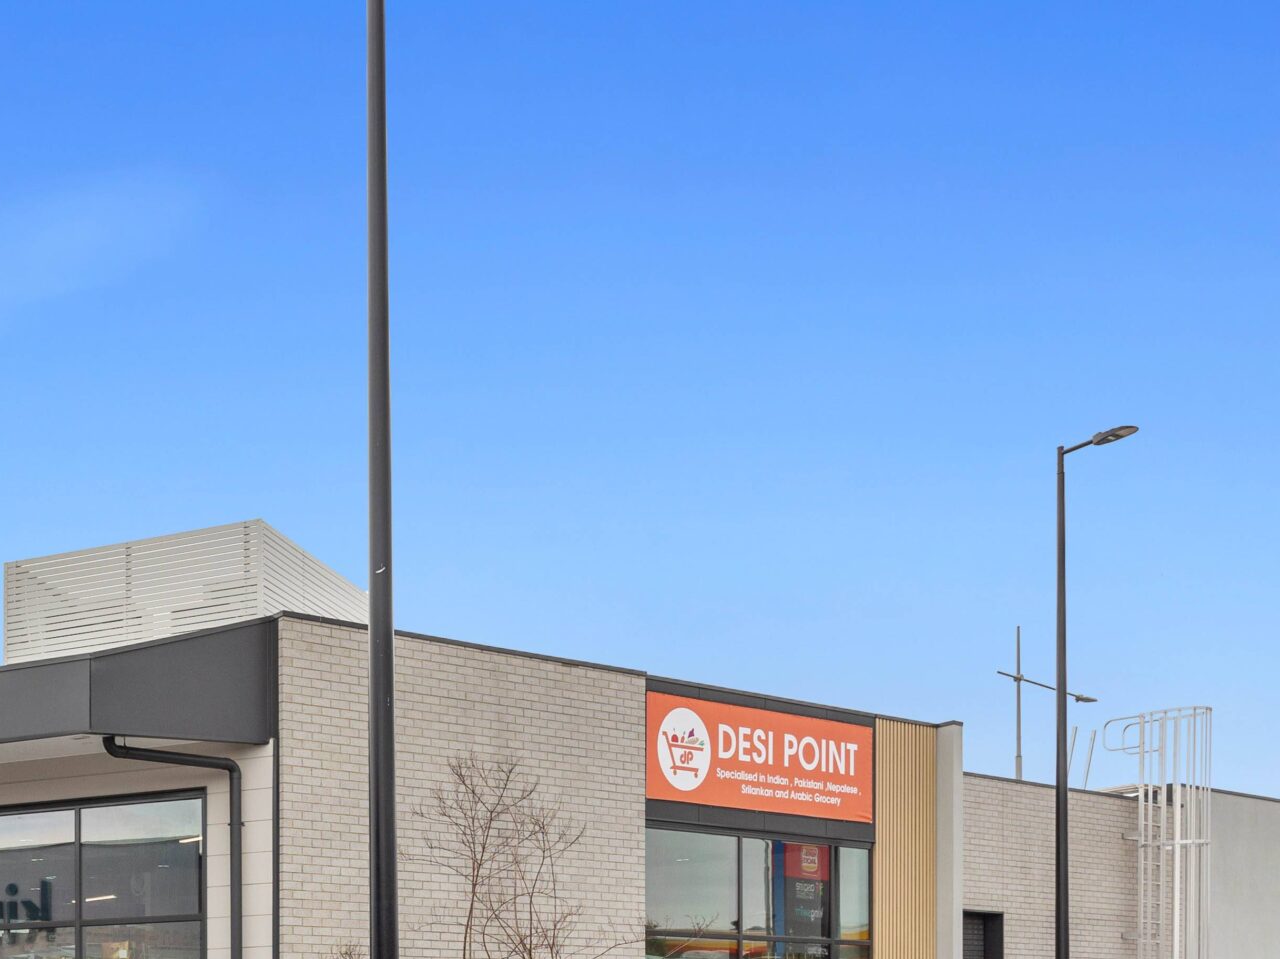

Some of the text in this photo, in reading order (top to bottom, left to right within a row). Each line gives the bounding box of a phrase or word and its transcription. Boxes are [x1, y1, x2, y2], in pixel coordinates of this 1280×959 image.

[718, 723, 858, 776] DESI POINT
[716, 767, 758, 782] Specialised
[759, 774, 766, 782] in
[794, 777, 824, 790] Pakistani
[741, 784, 841, 806] Srilankan and Arabic Grocery
